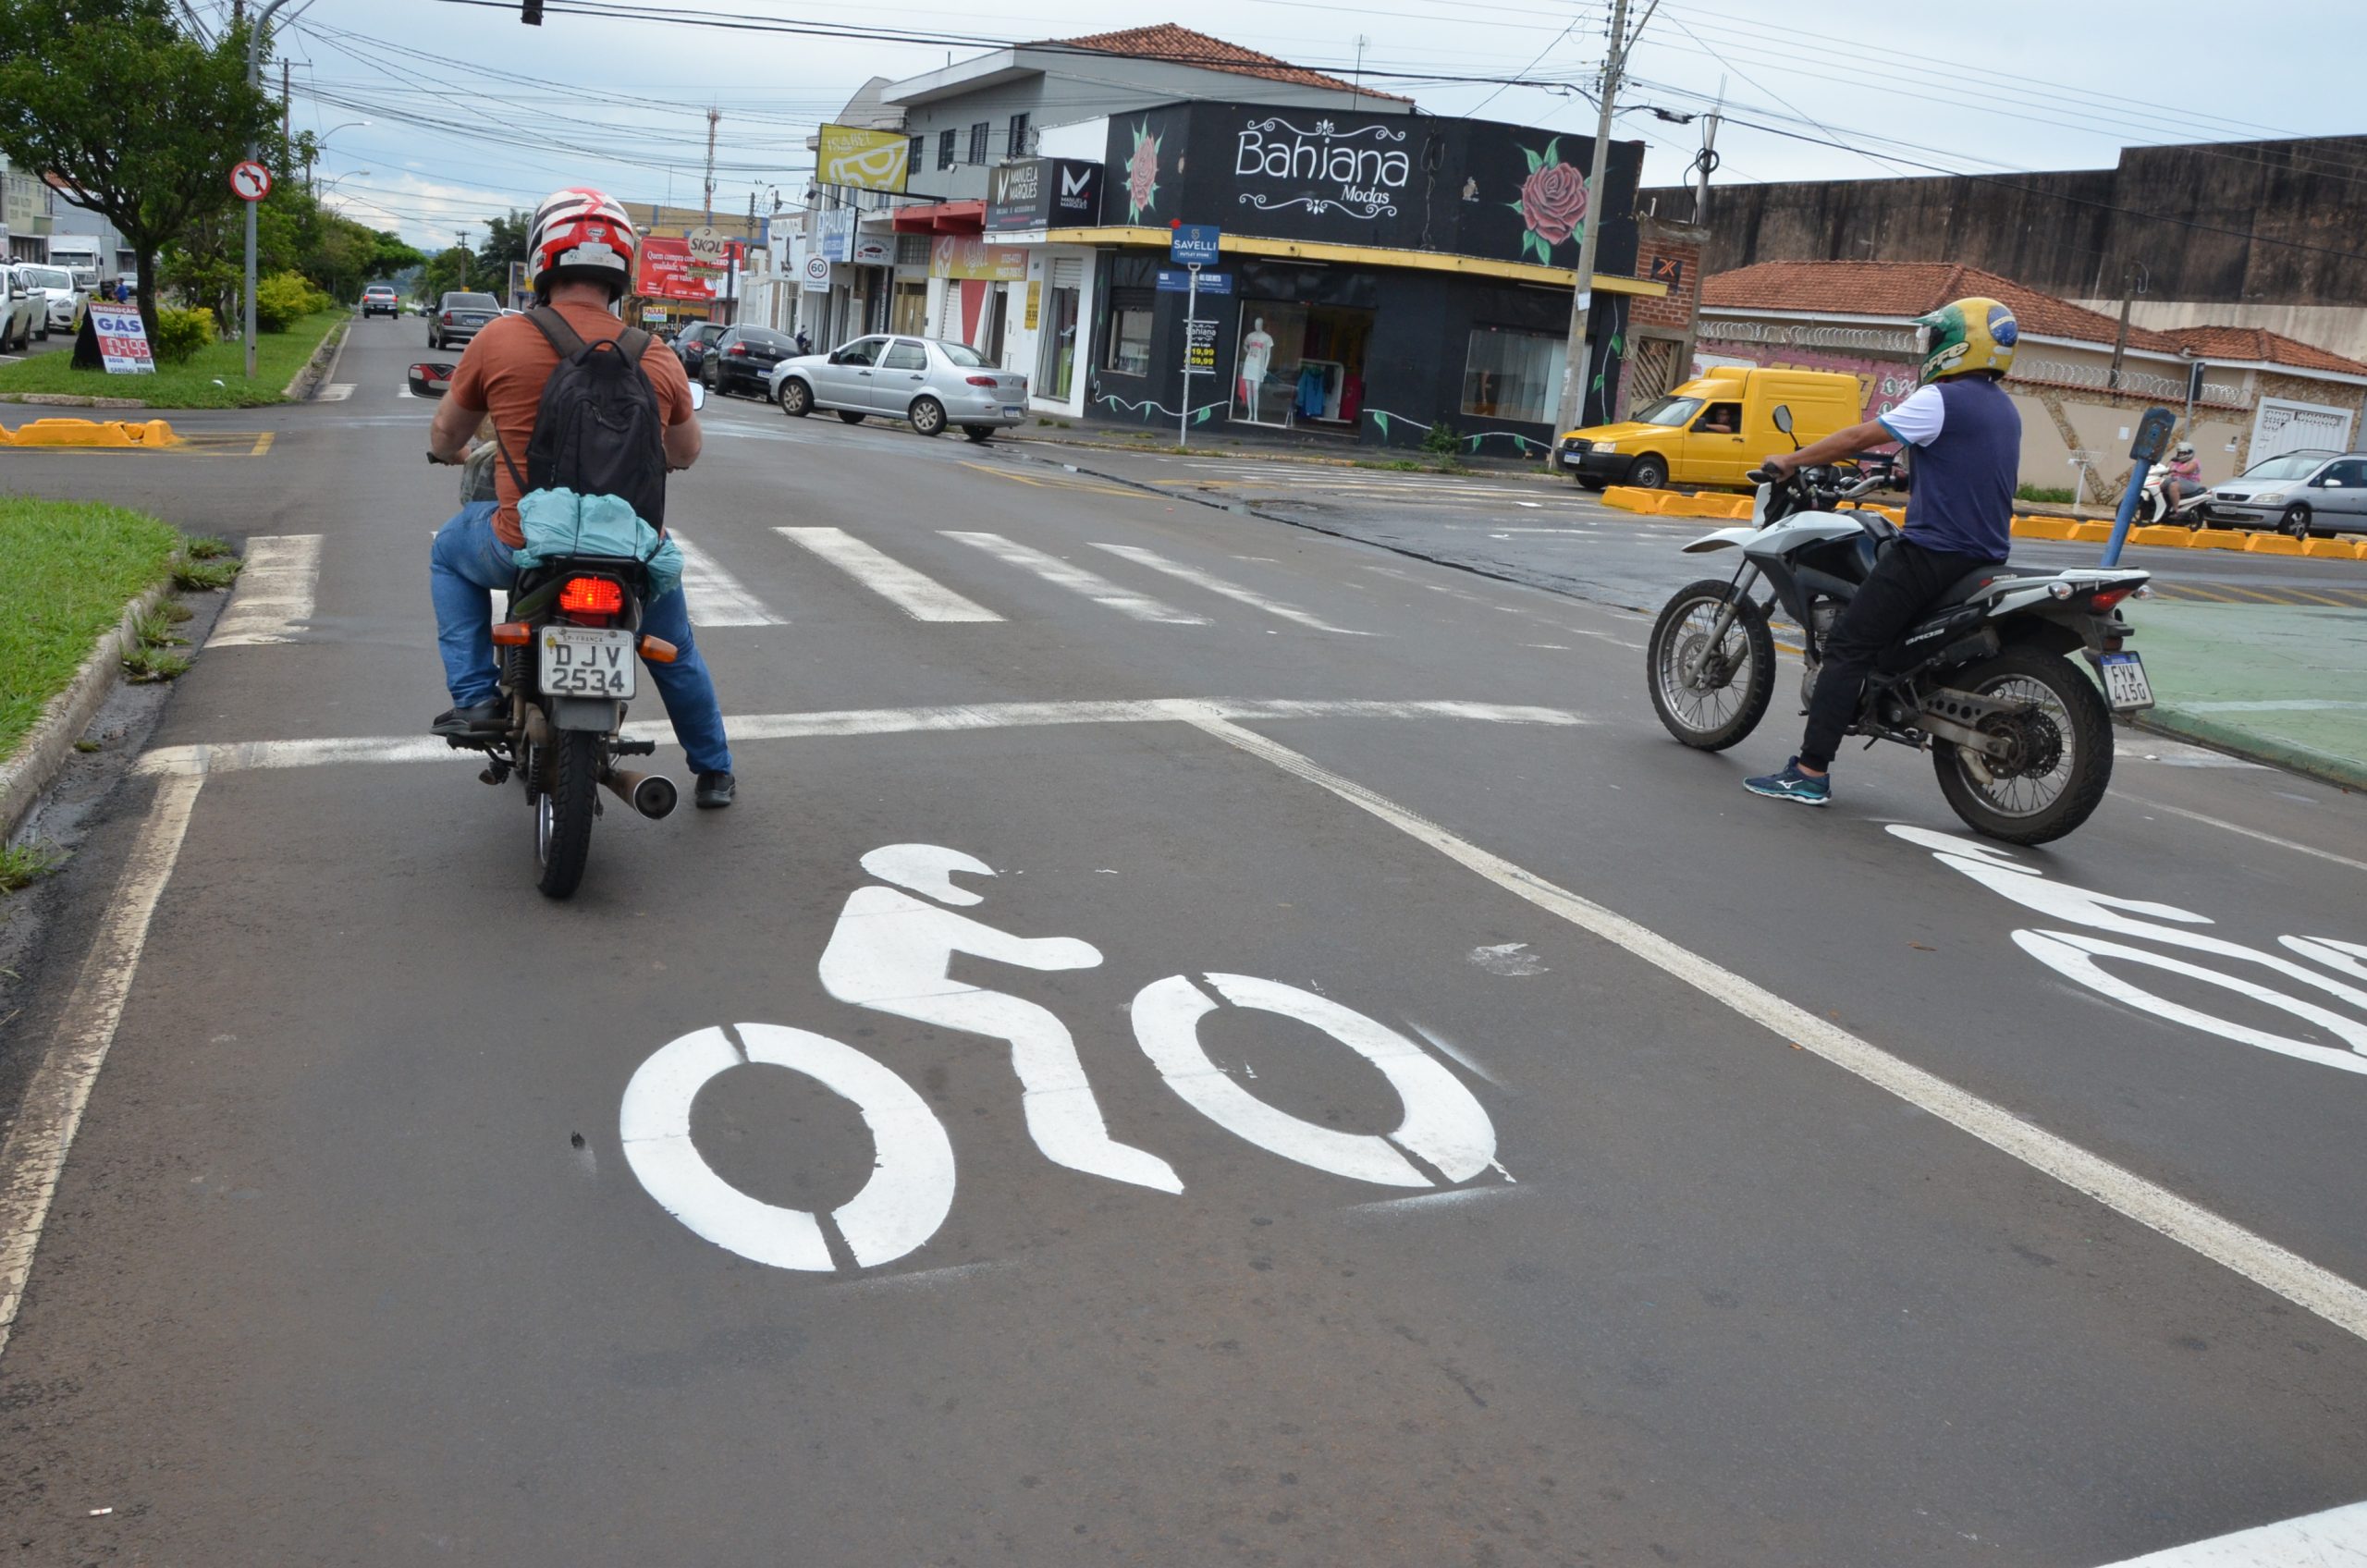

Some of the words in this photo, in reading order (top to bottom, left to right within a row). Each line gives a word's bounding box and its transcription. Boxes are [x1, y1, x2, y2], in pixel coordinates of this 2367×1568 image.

[1235, 130, 1410, 187] Bahiana
[1011, 166, 1038, 185] MANUELA
[1009, 183, 1037, 201] MARQUES
[1340, 185, 1390, 205] Modas
[691, 238, 721, 253] SKOL
[1173, 239, 1217, 251] SAVELLI
[811, 263, 824, 273] 60
[92, 306, 138, 314] PROMOÇÃO
[98, 316, 141, 332] GÁS
[552, 668, 624, 692] 2534
